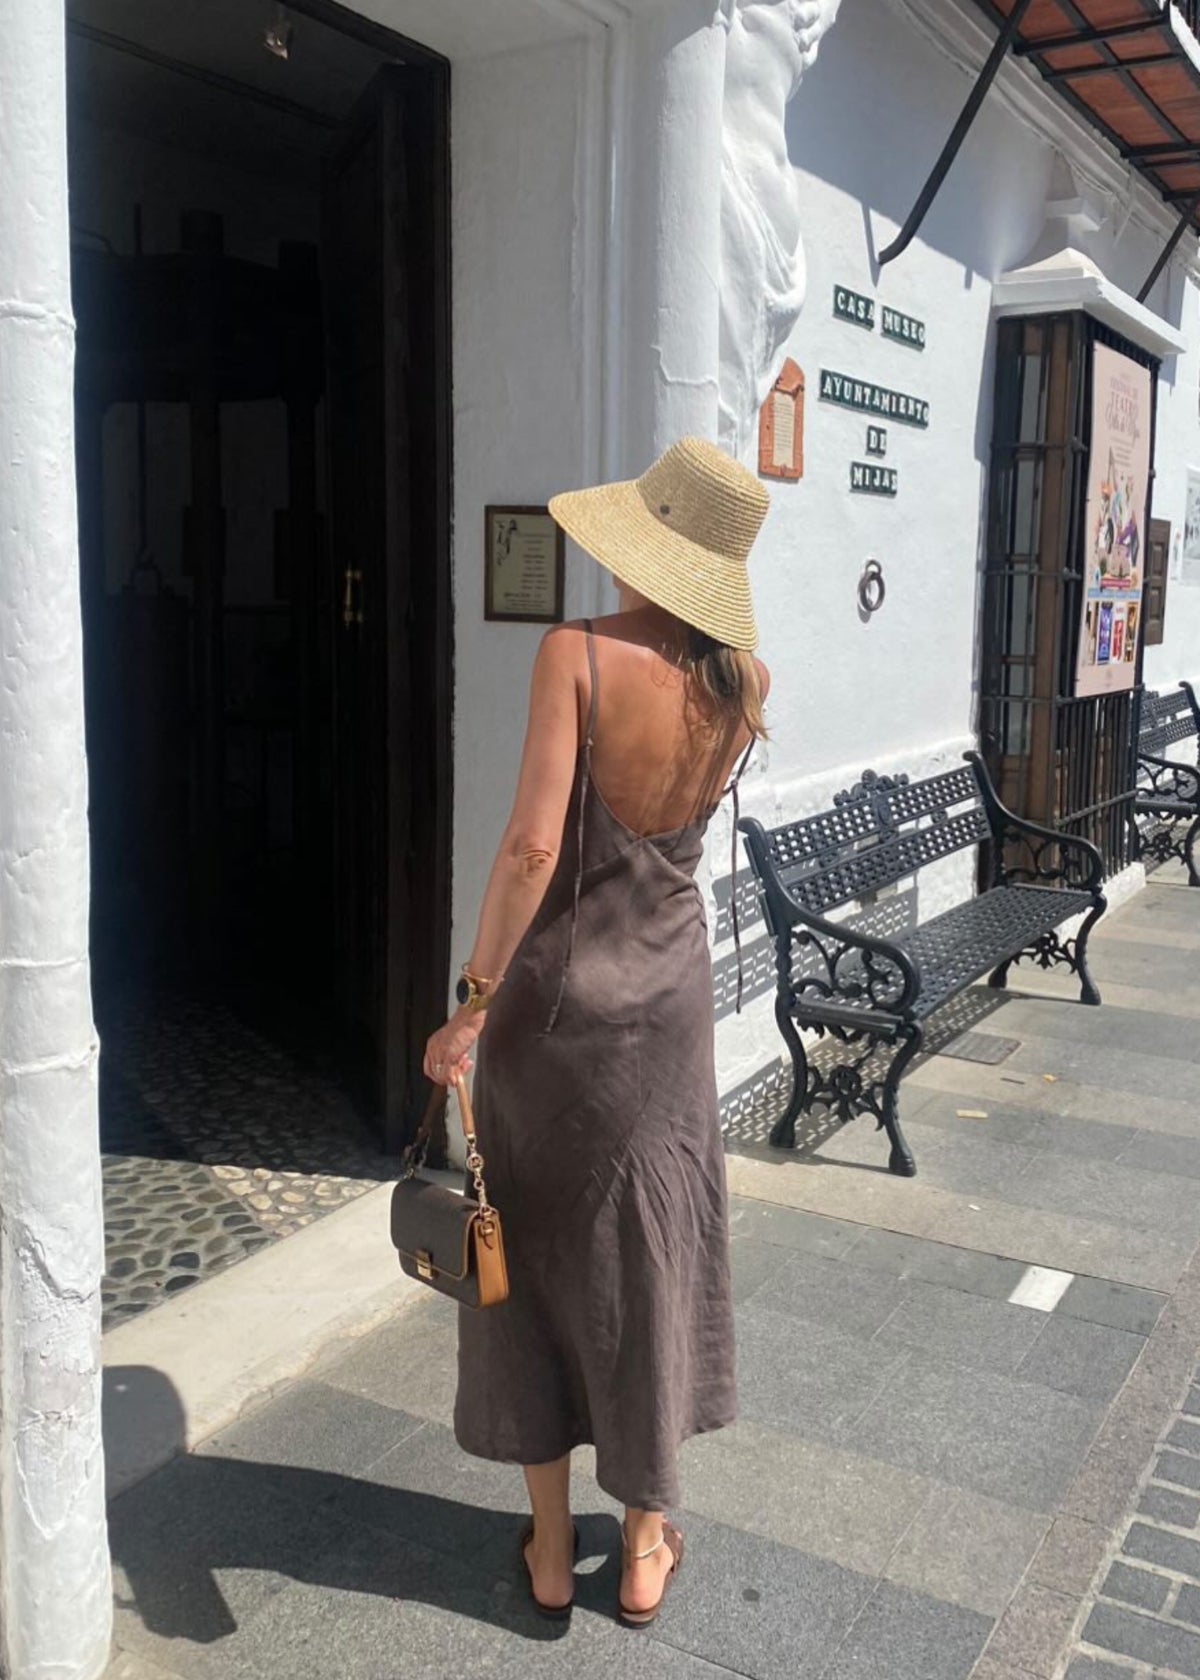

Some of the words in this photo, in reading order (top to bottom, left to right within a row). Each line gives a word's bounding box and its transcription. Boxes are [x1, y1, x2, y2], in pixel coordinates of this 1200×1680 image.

[837, 291, 875, 320] CASA
[883, 309, 925, 344] MUSEO
[822, 374, 930, 422] AYUNTAMIENTO
[868, 430, 887, 451] DE
[852, 465, 898, 491] MIJAS
